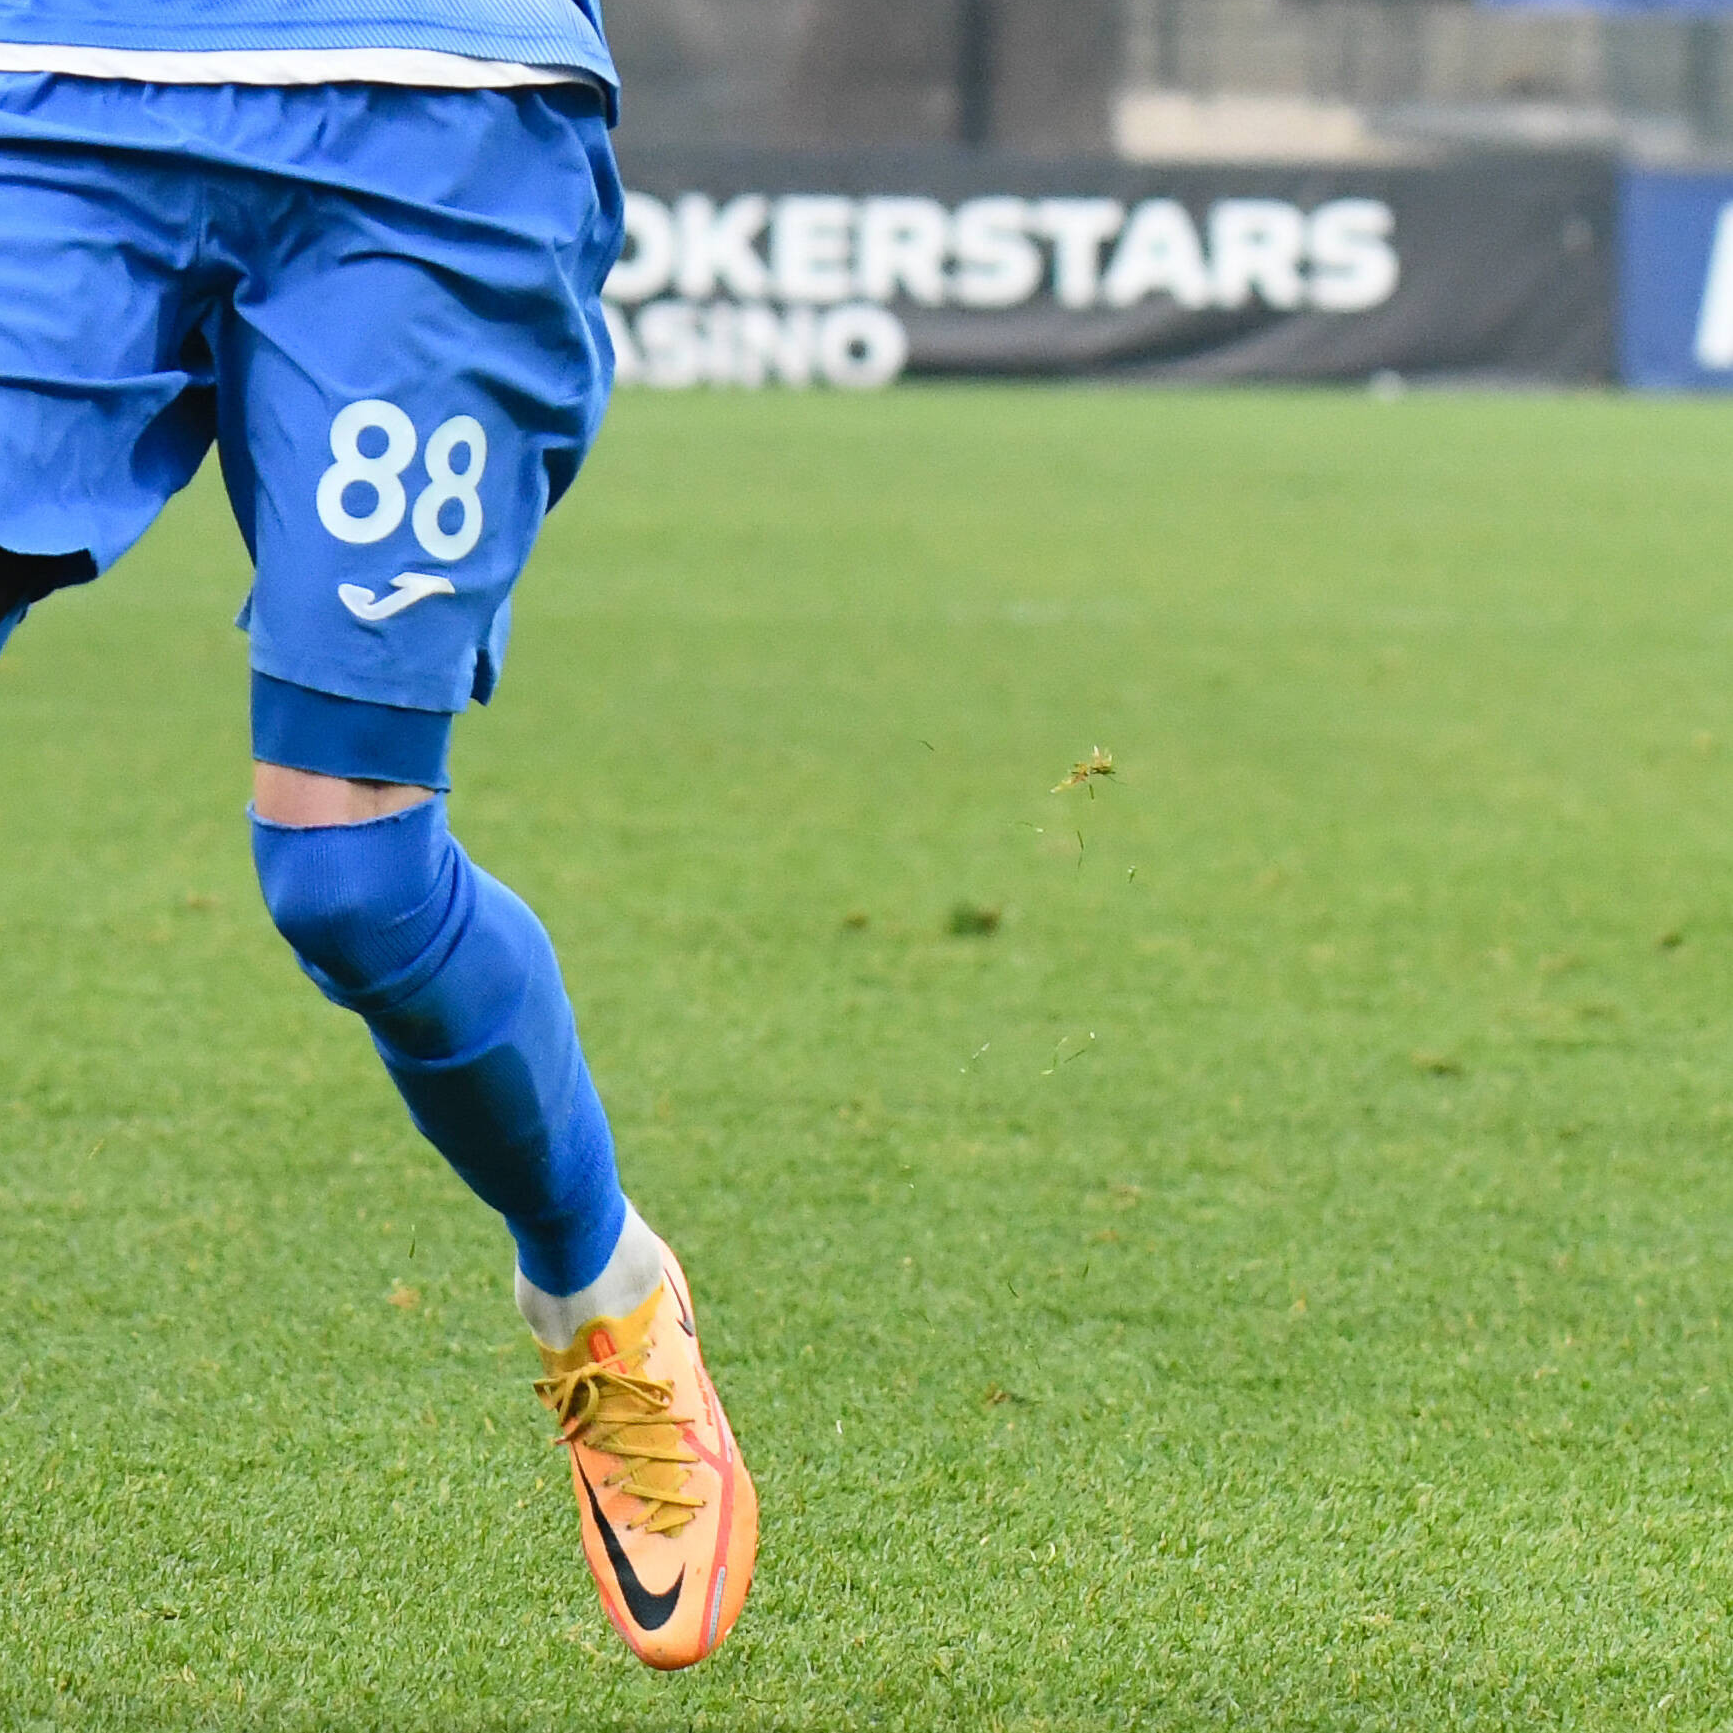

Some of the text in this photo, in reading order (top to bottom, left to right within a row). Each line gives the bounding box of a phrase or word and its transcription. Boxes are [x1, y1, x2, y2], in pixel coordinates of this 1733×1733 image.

[601, 190, 1401, 314] OKERSTARS
[600, 298, 909, 390] SINO
[316, 398, 487, 561] 88
